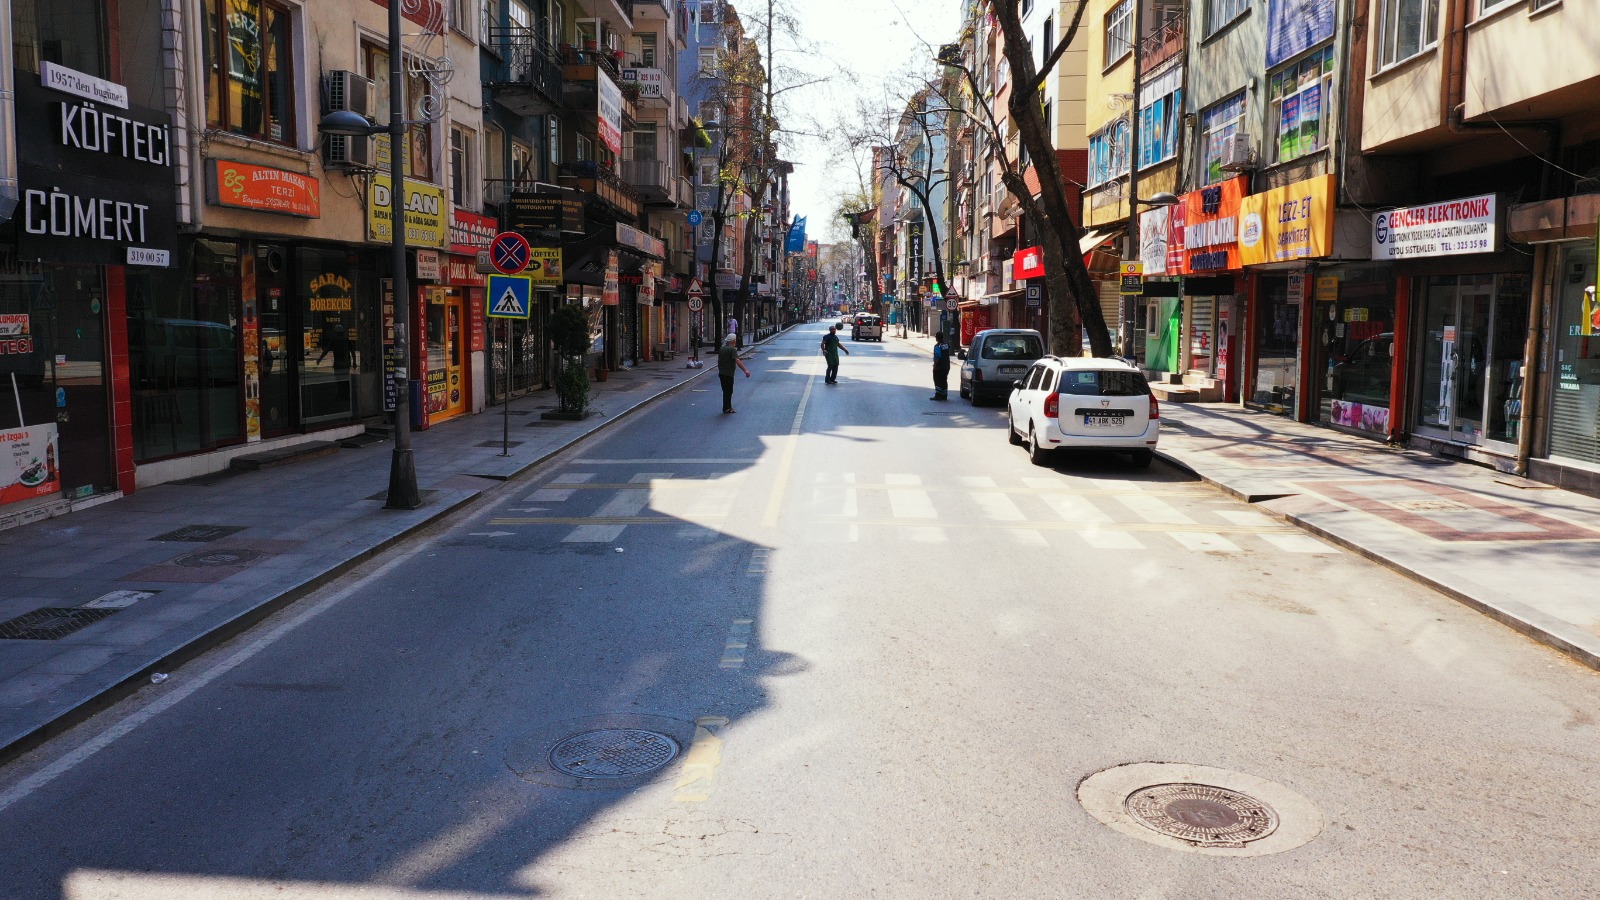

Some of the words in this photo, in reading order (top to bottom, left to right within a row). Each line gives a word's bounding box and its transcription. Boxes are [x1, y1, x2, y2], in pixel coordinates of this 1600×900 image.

[50, 69, 91, 95] 1957'den
[61, 102, 171, 167] KÖFTECİ
[252, 169, 280, 182] ALTIN
[281, 171, 306, 190] MAKAS
[271, 185, 295, 198] TERZİ
[374, 184, 439, 216] DAN
[25, 187, 149, 243] CÖMERT
[374, 210, 388, 221] BAYAN
[1278, 195, 1313, 224] LEZZ-ET
[1388, 208, 1425, 230] GENÇLER
[1427, 197, 1489, 224] ELEKTRONİK
[131, 250, 144, 262] 319
[144, 251, 155, 264] 00
[155, 252, 165, 264] 57
[1388, 246, 1404, 256] UYDU
[1405, 244, 1437, 255] SİSTEMLERİ
[1441, 242, 1452, 252] TEL
[1457, 240, 1468, 250] 325
[1469, 240, 1478, 250] 35
[1479, 239, 1488, 249] 98
[309, 273, 352, 293] SARAY
[1030, 288, 1037, 297] D
[309, 295, 352, 314] BÖREKÇİSİ
[690, 299, 701, 309] 30
[947, 299, 957, 308] 30
[1111, 416, 1123, 424] 525
